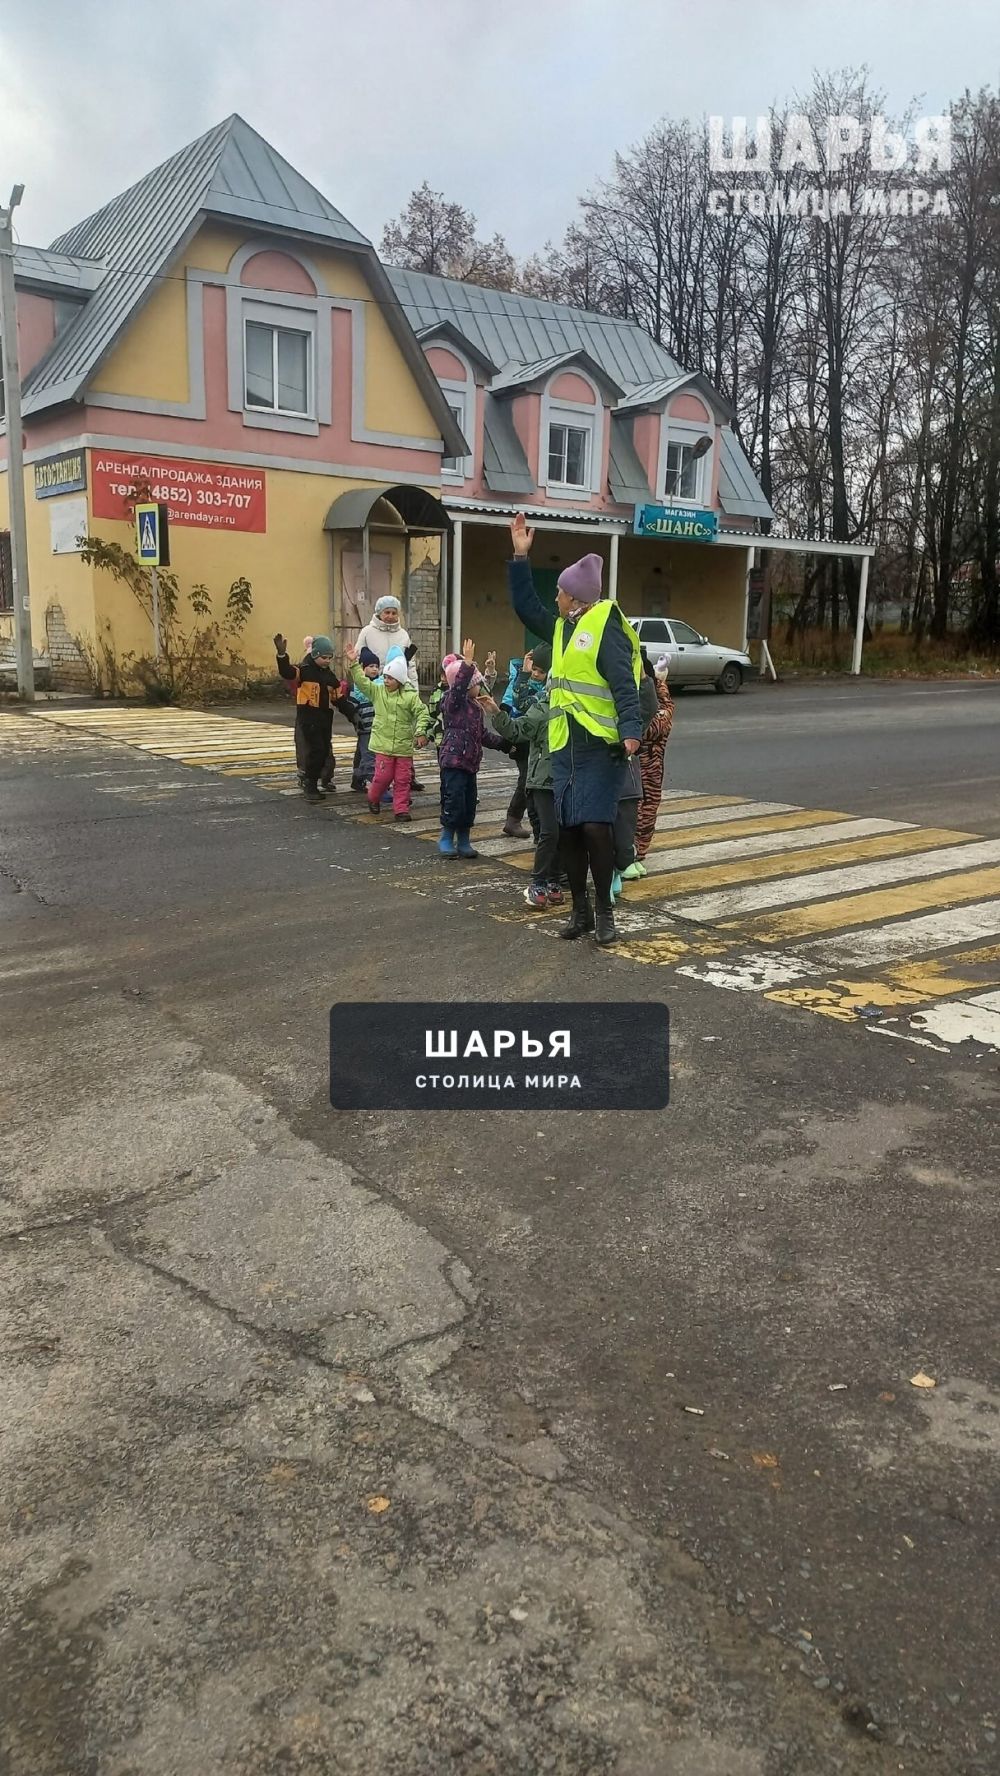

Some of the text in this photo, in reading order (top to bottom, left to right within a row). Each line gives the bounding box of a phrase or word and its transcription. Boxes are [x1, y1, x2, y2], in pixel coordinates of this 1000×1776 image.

[36, 456, 82, 489] АВТОСТАНЦИЯ
[96, 460, 263, 490] АРЕНДА/ПРОДАЖА ЗДАНИЯ
[196, 490, 251, 509] 303-707
[664, 508, 697, 519] МАГАЗИН
[646, 518, 712, 536] «ШАНС»
